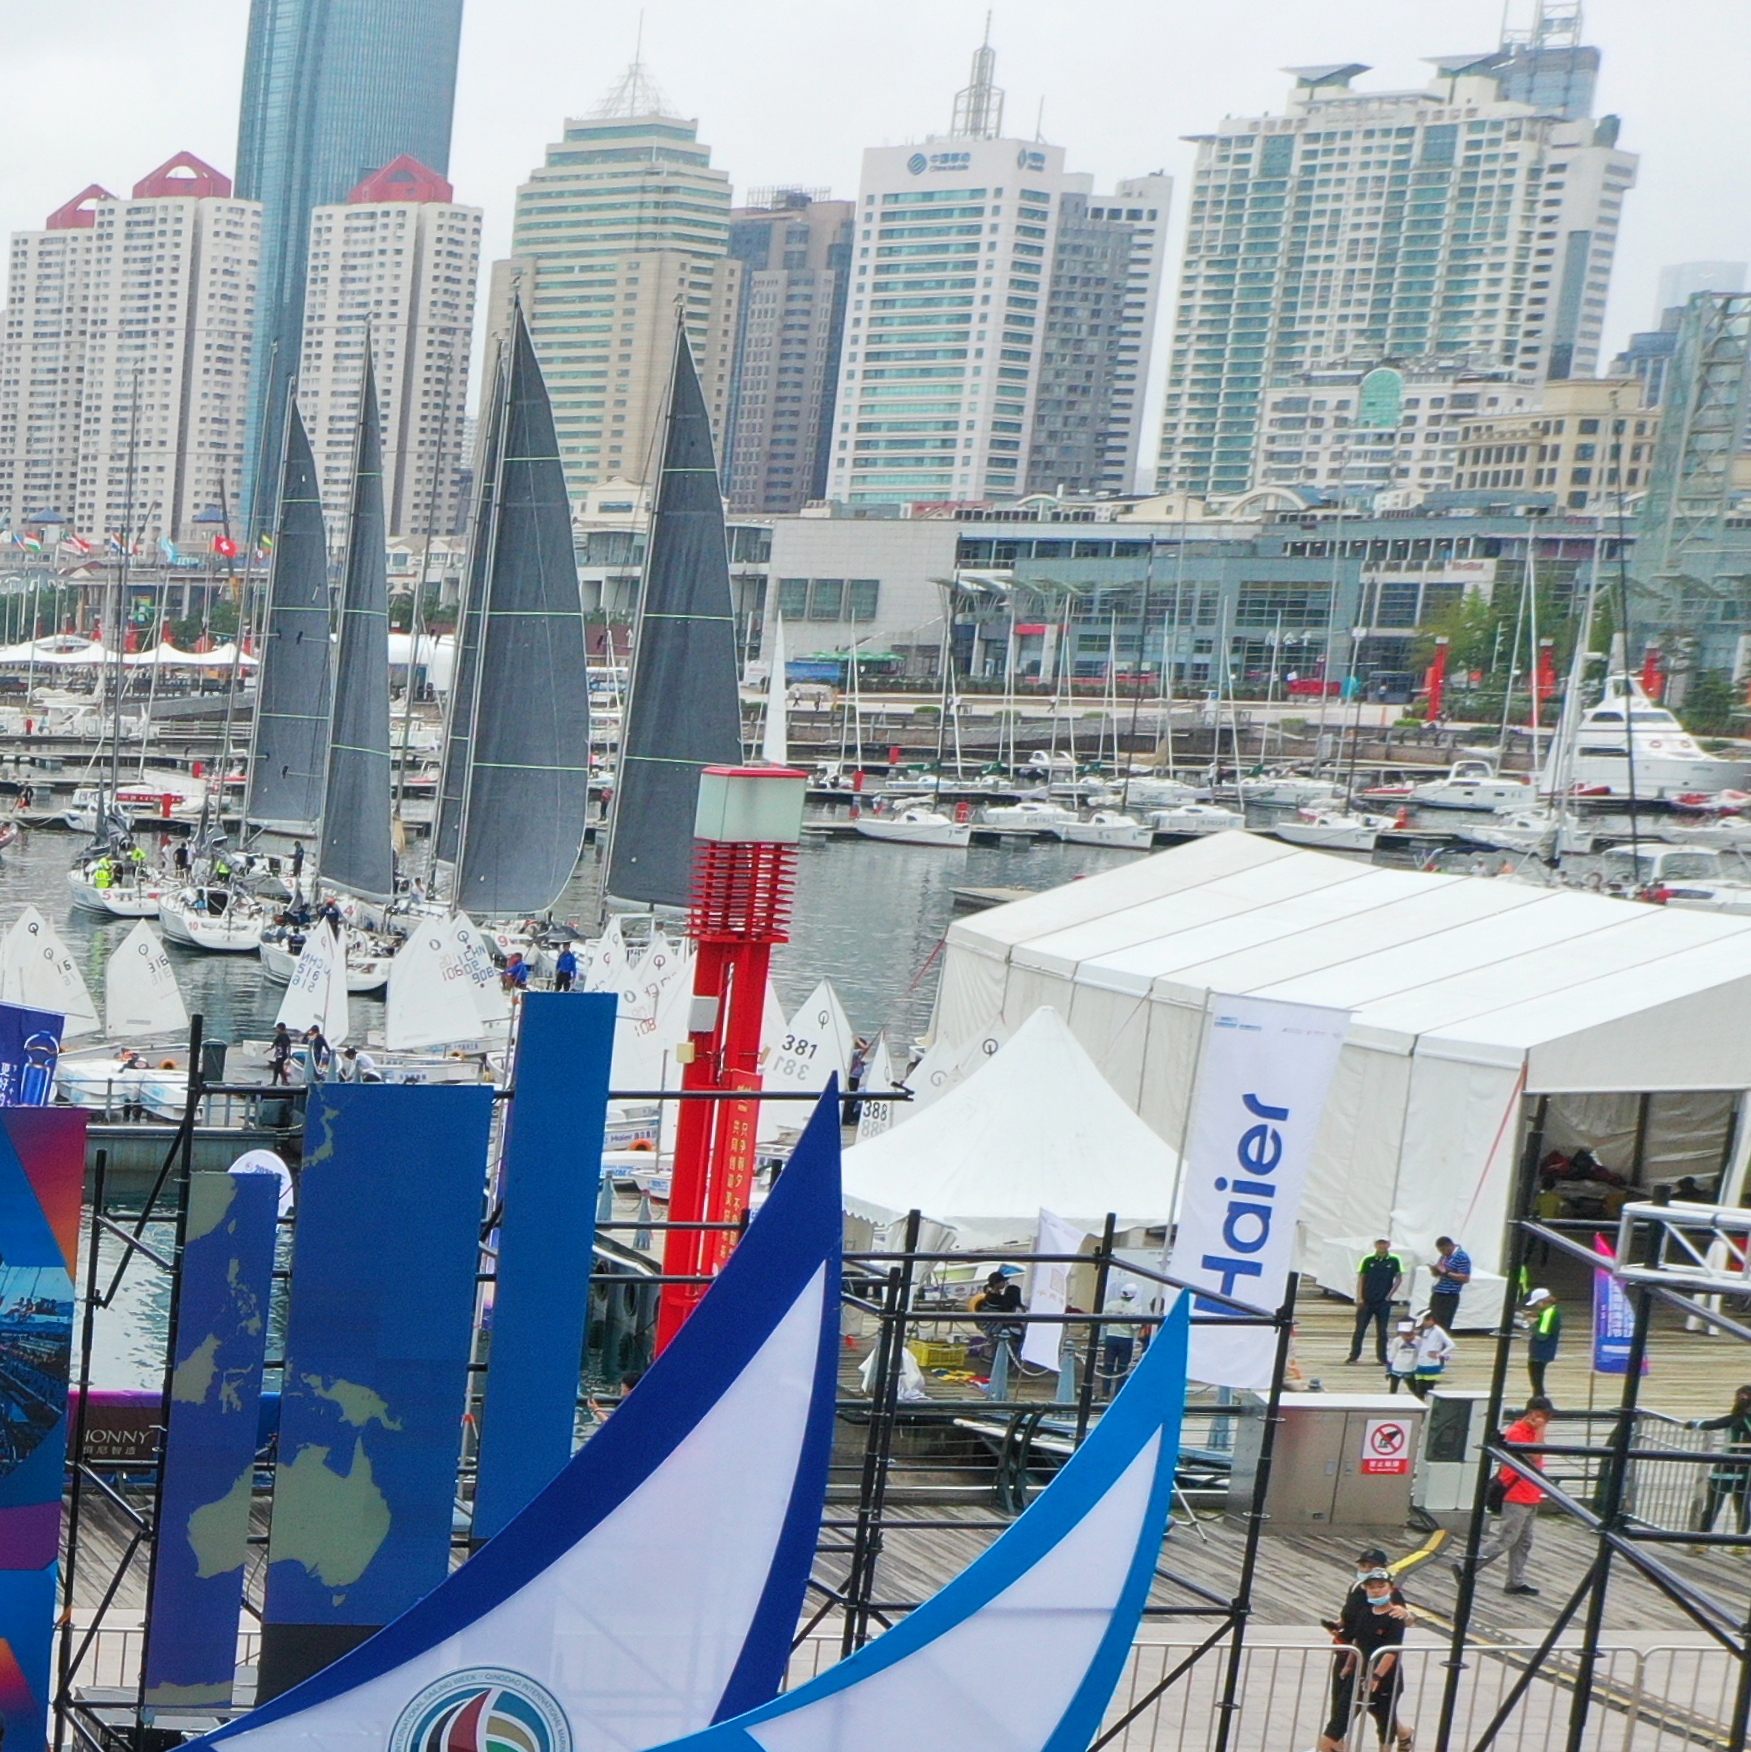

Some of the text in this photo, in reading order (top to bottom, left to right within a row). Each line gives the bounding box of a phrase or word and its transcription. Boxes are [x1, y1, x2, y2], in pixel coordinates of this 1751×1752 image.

[102, 889, 112, 901] 5
[188, 921, 199, 932] 10
[781, 1034, 819, 1060] 381
[1194, 1092, 1290, 1312] Haier
